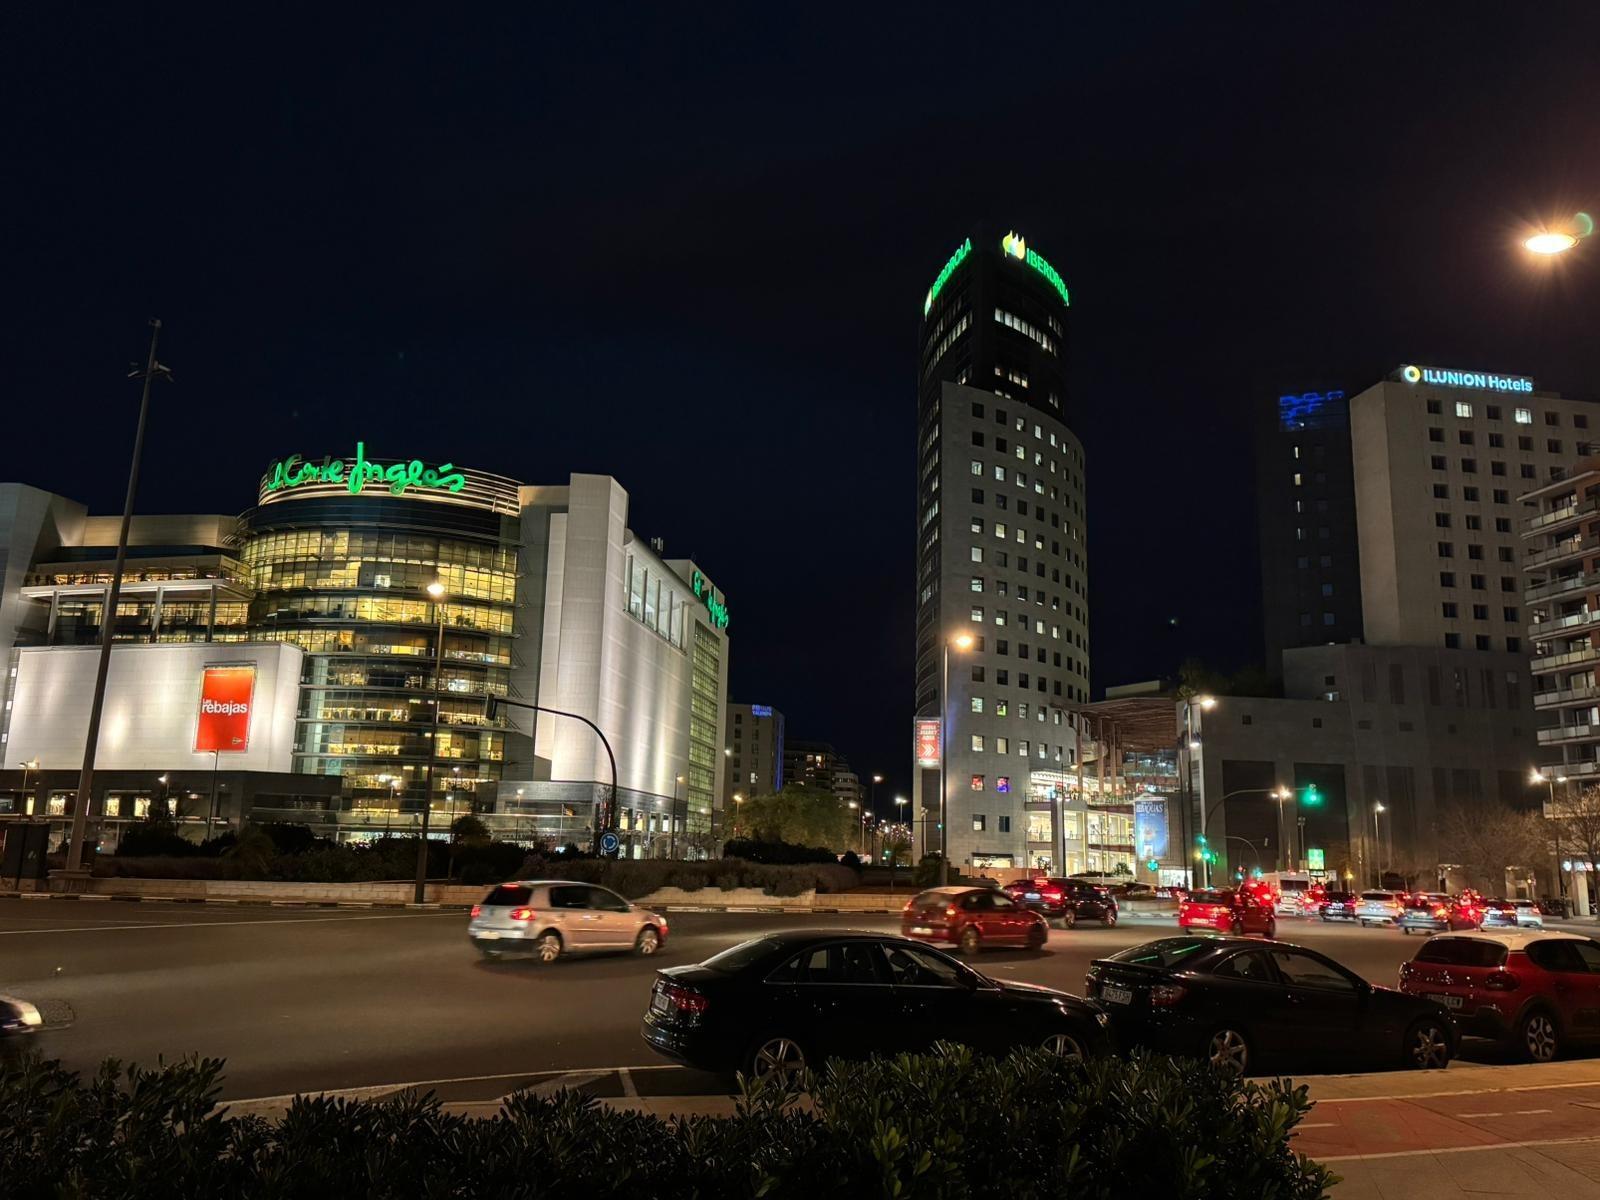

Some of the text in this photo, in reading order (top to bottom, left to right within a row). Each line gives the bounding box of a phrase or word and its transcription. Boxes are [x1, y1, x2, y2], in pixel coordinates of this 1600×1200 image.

[1423, 369, 1533, 393] ILUNION Hotels
[202, 700, 248, 716] rebajas
